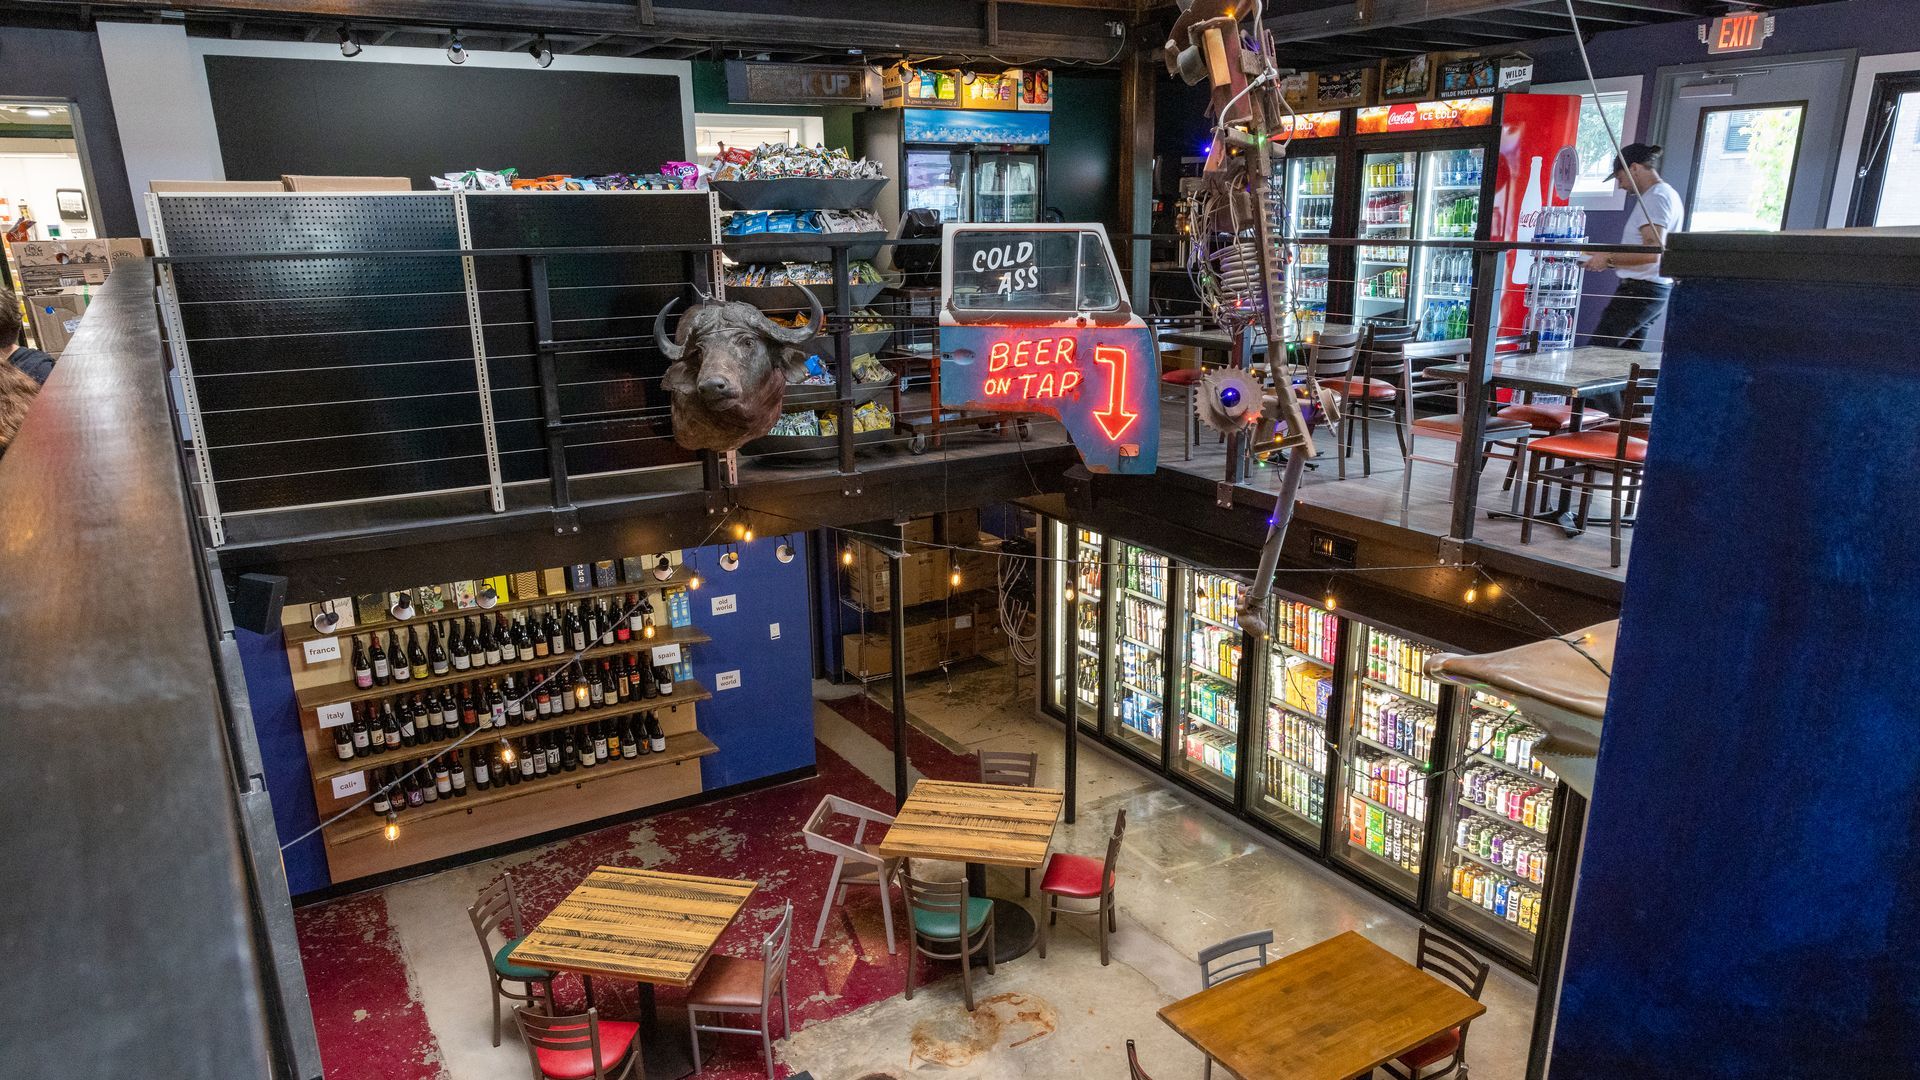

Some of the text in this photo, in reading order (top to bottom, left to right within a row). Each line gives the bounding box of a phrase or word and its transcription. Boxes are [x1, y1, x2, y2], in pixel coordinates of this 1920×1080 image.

[1718, 15, 1759, 49] EXIT
[1505, 68, 1527, 79] WILDE
[821, 74, 850, 95] UP
[1441, 86, 1496, 98] WILDE PROTEIN CHIPS
[1419, 112, 1434, 121] ICE
[1435, 109, 1458, 120] COLD
[972, 241, 1034, 273] COLD
[997, 264, 1039, 295] ASS
[989, 337, 1077, 373] BEER
[983, 371, 1083, 399] ON TAP
[715, 603, 733, 612] world
[309, 645, 336, 656] france
[657, 651, 676, 661] spain
[720, 679, 737, 687] world
[326, 711, 345, 720] italy
[339, 781, 357, 790] cali+
